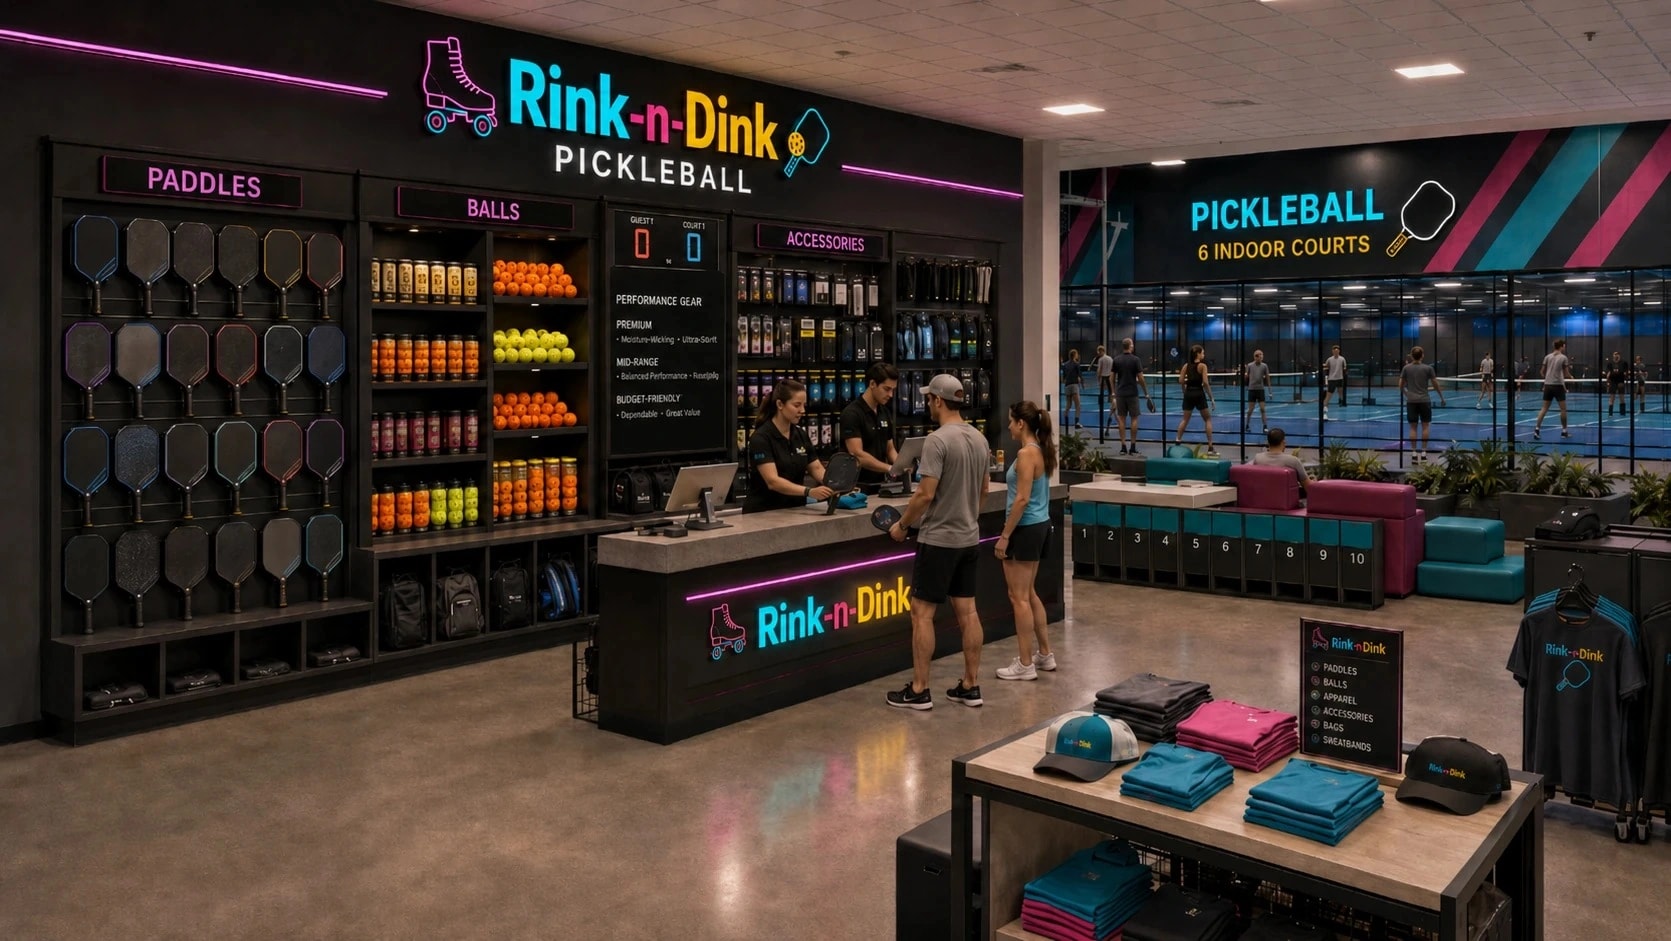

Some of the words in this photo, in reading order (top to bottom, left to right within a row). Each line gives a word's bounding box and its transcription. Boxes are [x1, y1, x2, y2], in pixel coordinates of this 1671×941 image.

[510, 58, 779, 160] Rink-n-Dink
[555, 145, 751, 193] PICKLEBALL
[148, 167, 261, 198] PADDLES
[468, 198, 520, 220] BALLS
[1192, 188, 1384, 231] PICKLEBALL
[634, 228, 650, 259] 0
[687, 232, 701, 262] 0
[787, 231, 865, 252] ACCESSORIES
[1198, 244, 1208, 261] 6
[1214, 240, 1285, 260] INDOOR
[1291, 235, 1370, 256] COURTS
[616, 294, 678, 306] PERFORMANCE
[680, 297, 702, 307] GEAR
[616, 320, 652, 329] PREMIUM
[616, 358, 659, 367] MID-RANGE
[616, 394, 681, 404] BUDGET-FRIENDLY
[621, 410, 658, 420] Dependable
[1082, 528, 1087, 538] 1
[1107, 530, 1114, 540] 2
[1134, 532, 1141, 543] 3
[1162, 535, 1169, 546] 4
[1193, 538, 1200, 549] 5
[1222, 541, 1229, 552] 6
[1255, 543, 1262, 555] 7
[1286, 546, 1294, 558] 8
[1319, 549, 1327, 561] 9
[1350, 552, 1365, 565] 10
[758, 576, 911, 648] Rink-n-Dink
[1323, 662, 1358, 676] PADDLES
[1323, 678, 1348, 689] BALLS
[1323, 692, 1358, 705] APPAREL
[1323, 707, 1374, 723] ACCESSORIES
[1323, 721, 1345, 732] BAGS
[1323, 735, 1372, 752] SWEATBANDS
